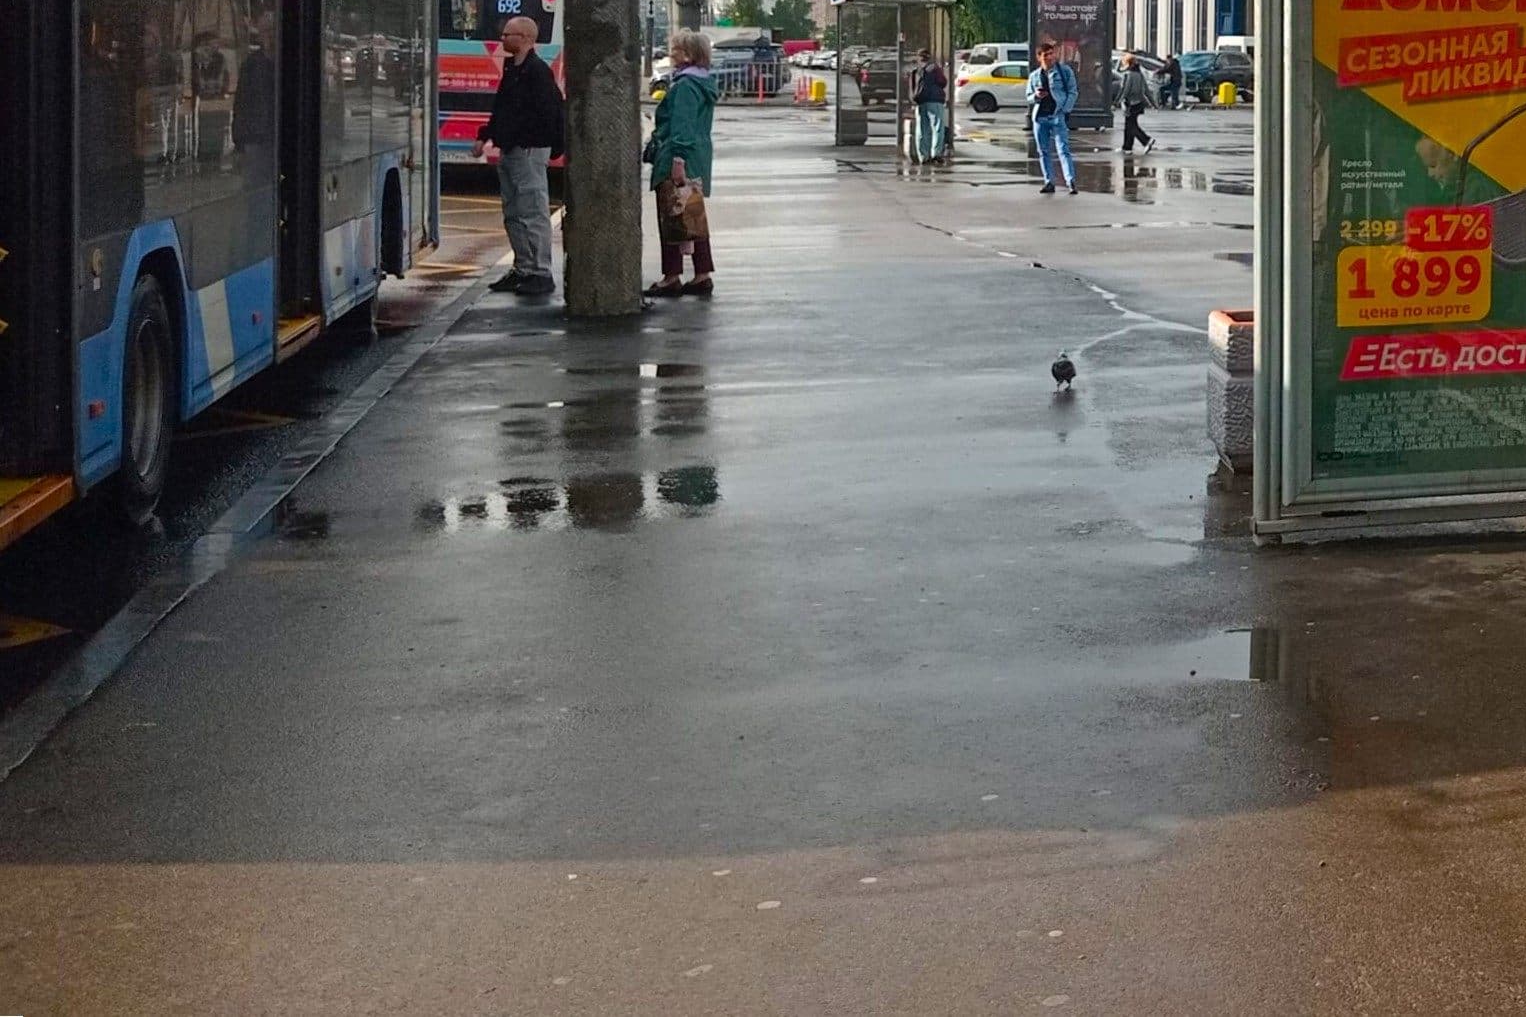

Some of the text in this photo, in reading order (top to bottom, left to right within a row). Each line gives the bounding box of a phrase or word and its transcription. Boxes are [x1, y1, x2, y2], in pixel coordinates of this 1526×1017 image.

[1346, 30, 1509, 73] СЕЗОННАЯ
[1408, 213, 1488, 242] -17%
[1348, 255, 1482, 299] 1 899
[1359, 302, 1471, 319] цена по карте
[1379, 342, 1447, 371] Есть
